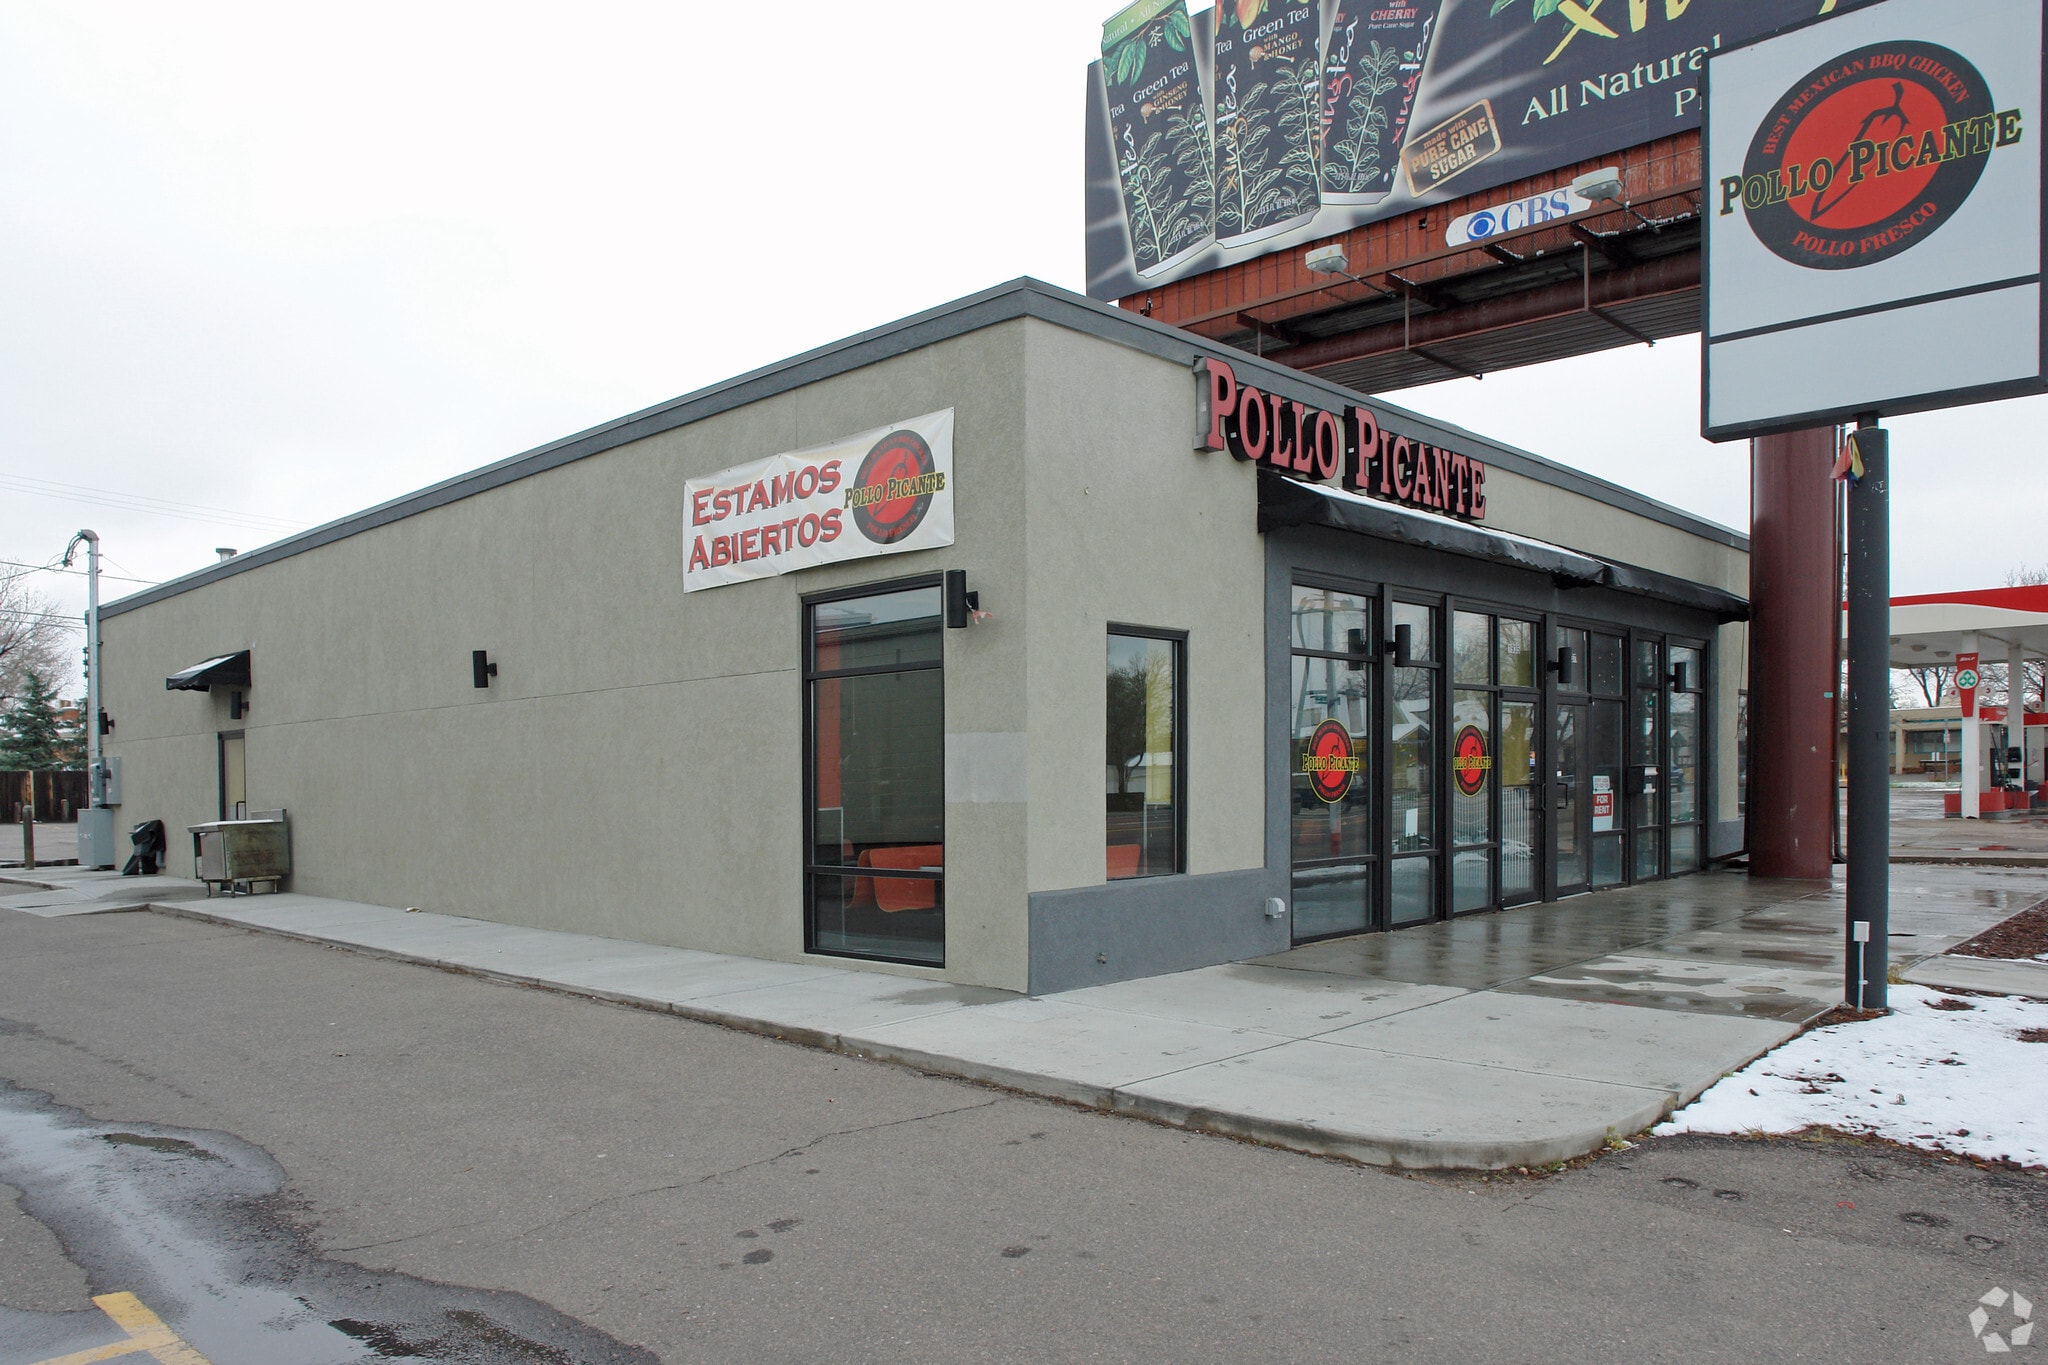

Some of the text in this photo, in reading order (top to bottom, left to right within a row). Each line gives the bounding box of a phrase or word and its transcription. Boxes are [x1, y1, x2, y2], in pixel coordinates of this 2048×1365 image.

[1243, 18, 1284, 43] Green
[1287, 7, 1310, 25] Tea
[1370, 8, 1418, 21] CHERRY
[1215, 40, 1232, 55] Tea
[1264, 32, 1298, 51] MANGO
[1132, 75, 1169, 104] Green
[1169, 61, 1189, 80] Tea
[1153, 81, 1188, 107] GINSENG
[1110, 103, 1125, 119] Tea
[1521, 84, 1569, 126] All
[1762, 53, 1970, 155] BEST MEXICAN BBQ CHICKEN
[1410, 117, 1489, 173] PURE CANE
[1423, 118, 1468, 149] made with
[1430, 145, 1477, 181] SUGAR
[1719, 108, 2024, 217] POLLO PICANTE
[1501, 188, 1570, 233] CBS
[1792, 200, 1937, 257] POLLO FRESCO
[1205, 356, 1486, 520] POLLO PICANTE
[692, 460, 842, 527] ESTAMOS
[844, 471, 946, 509] POLLO PICANTE
[687, 508, 844, 574] ABIERTOS
[1594, 805, 1610, 815] RENT
[1596, 795, 1609, 804] FOR
